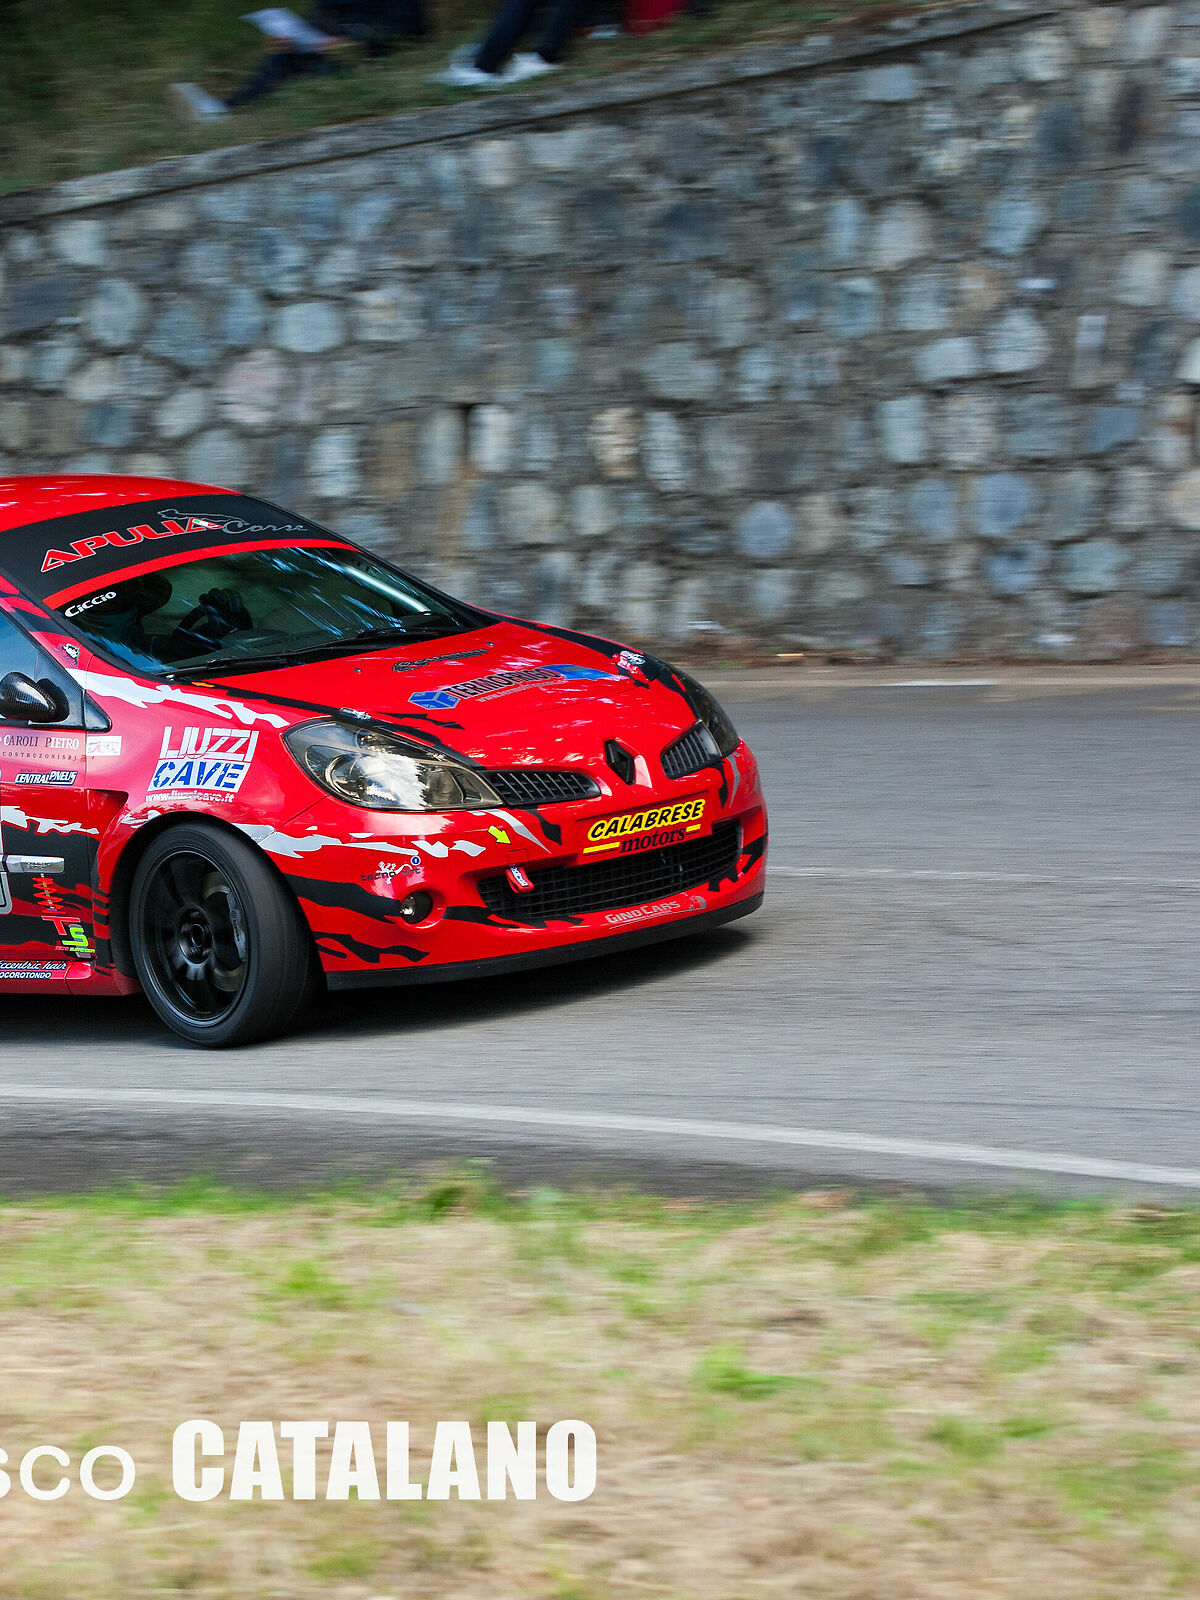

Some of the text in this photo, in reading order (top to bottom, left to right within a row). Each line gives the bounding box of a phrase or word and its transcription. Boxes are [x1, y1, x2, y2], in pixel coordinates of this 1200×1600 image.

[40, 517, 223, 573] APULIA
[64, 590, 117, 618] Ciccio
[3, 735, 40, 747] CAROLI
[45, 736, 80, 750] PIETRO
[153, 761, 245, 789] CAVE
[589, 800, 704, 839] CALABRESE
[620, 828, 685, 852] motors
[41, 960, 68, 970] hair
